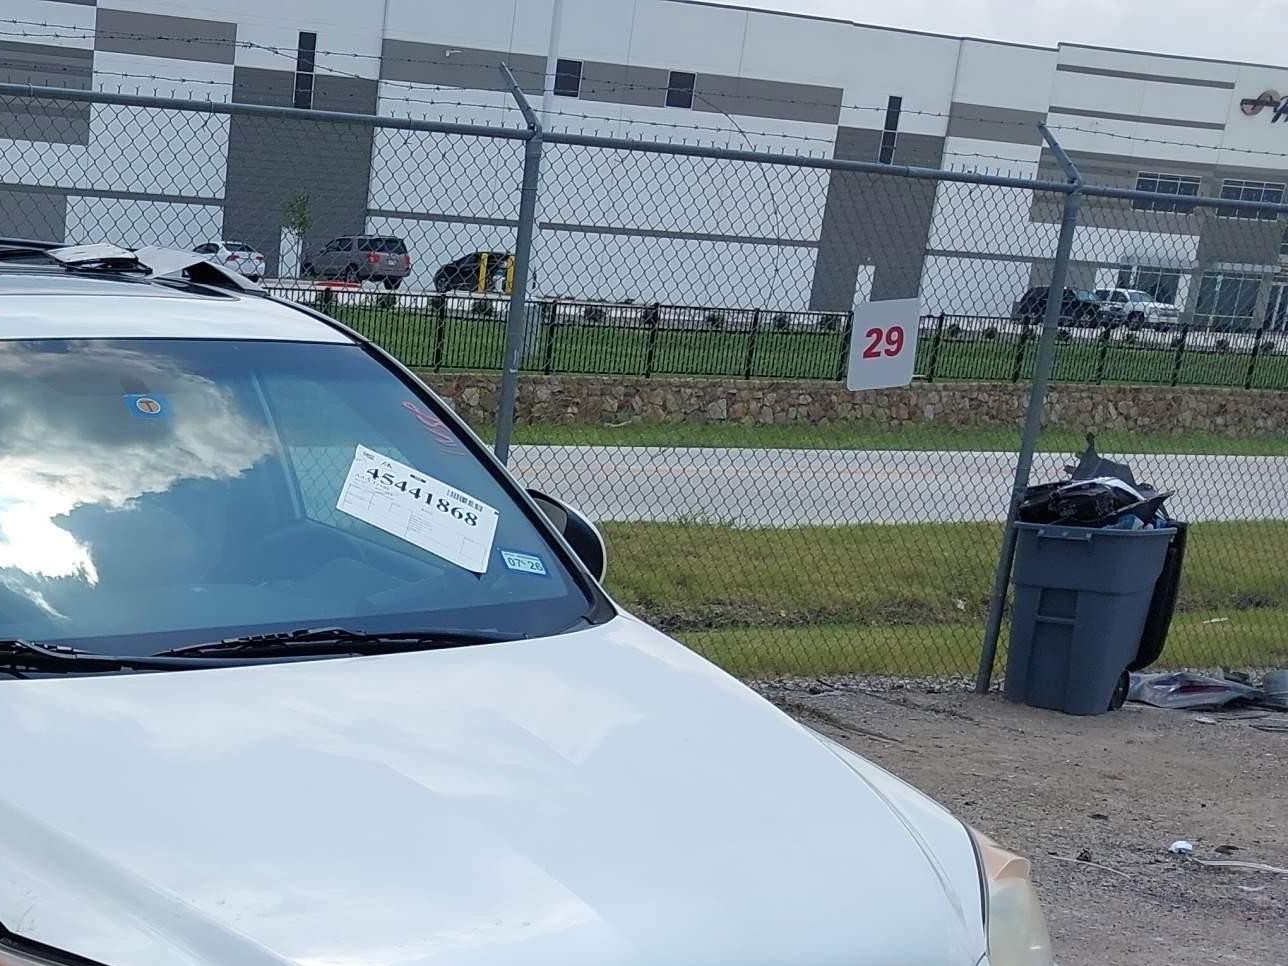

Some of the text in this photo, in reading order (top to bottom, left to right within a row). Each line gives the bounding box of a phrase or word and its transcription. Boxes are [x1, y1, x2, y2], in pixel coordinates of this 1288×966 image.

[862, 325, 904, 359] 29
[365, 467, 479, 528] 45441868
[507, 557, 521, 568] 07
